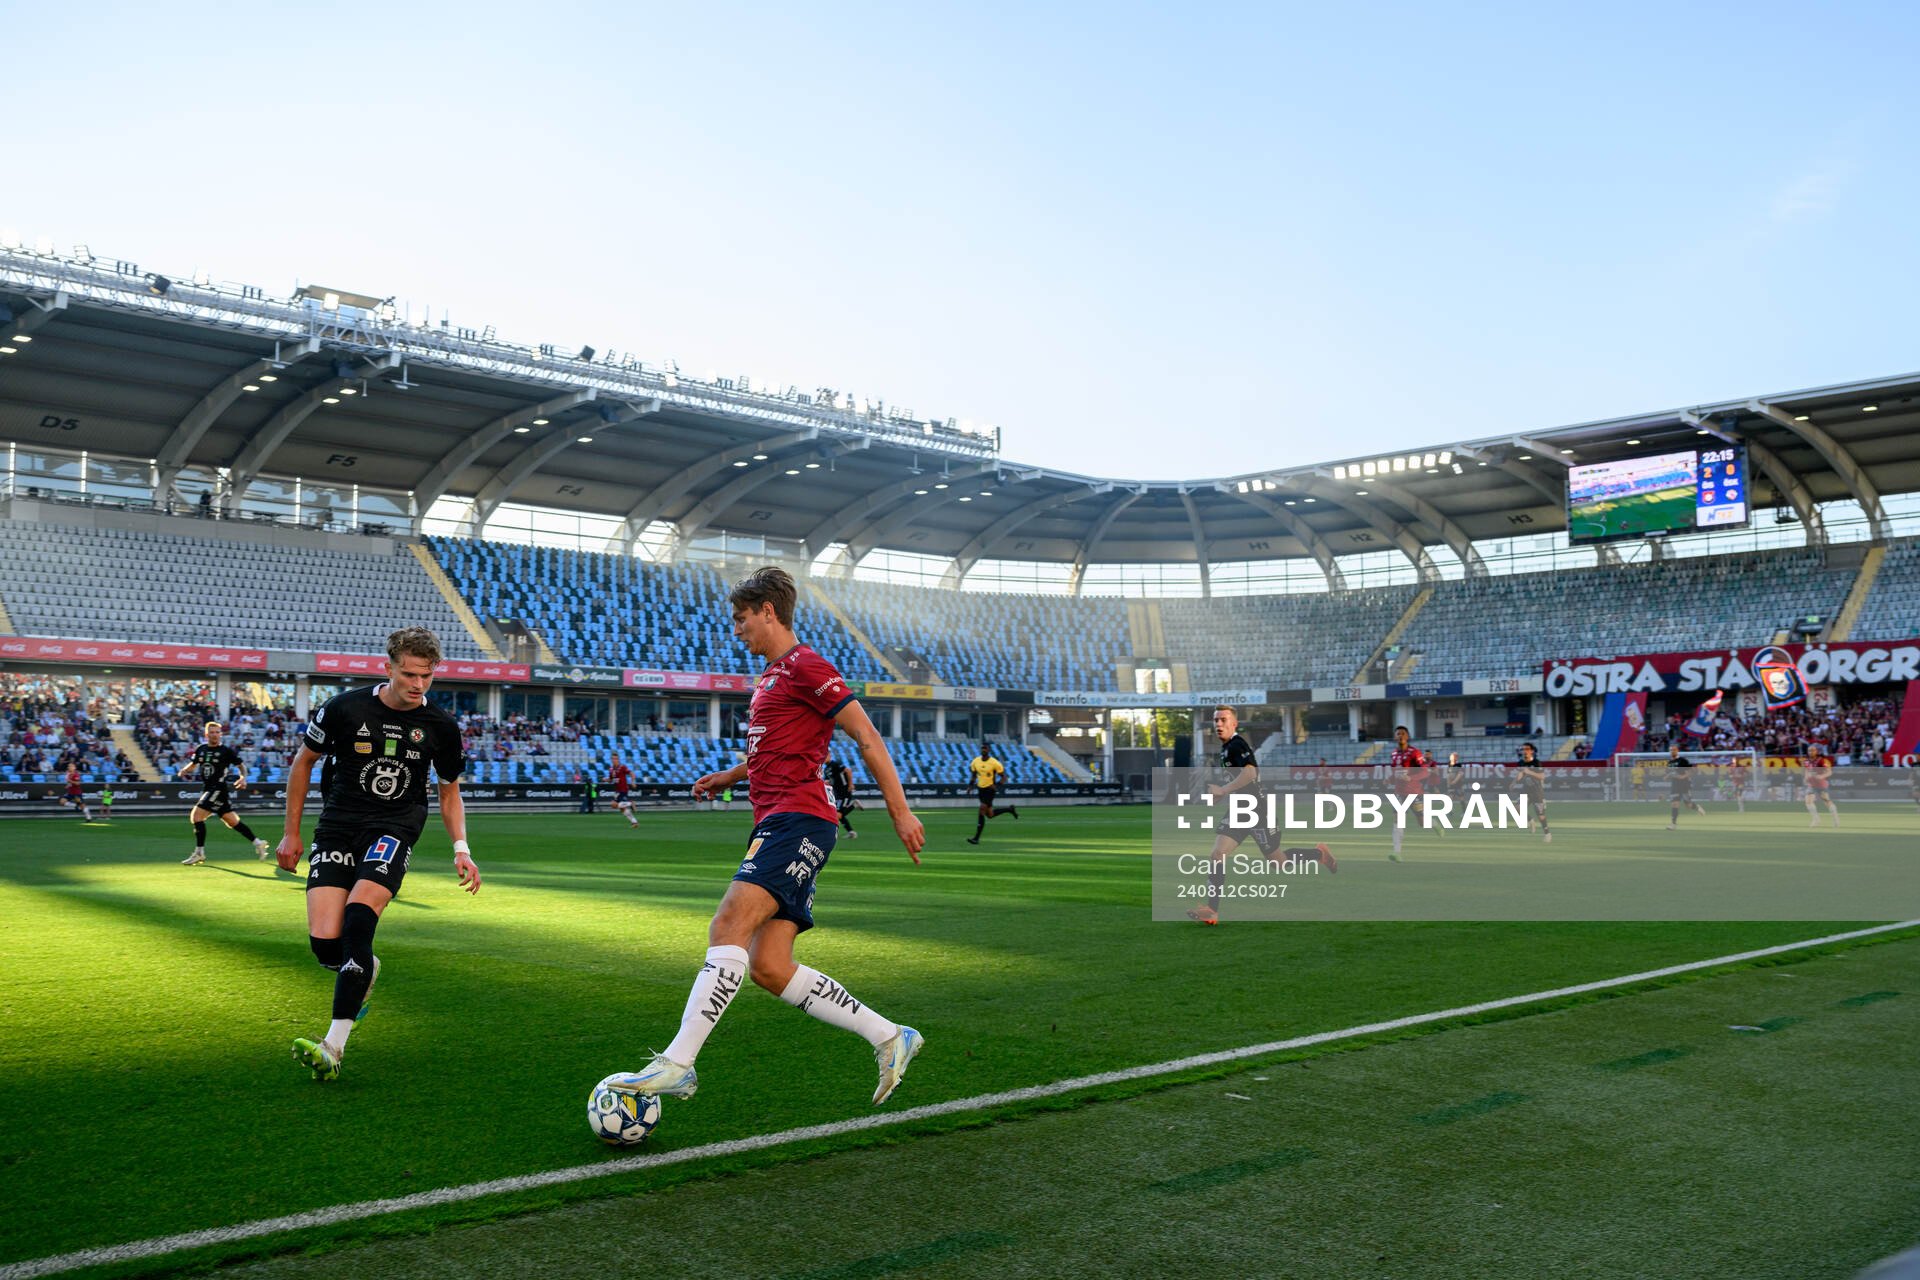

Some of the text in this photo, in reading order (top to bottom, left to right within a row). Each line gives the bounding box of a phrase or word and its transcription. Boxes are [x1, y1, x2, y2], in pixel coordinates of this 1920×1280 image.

[39, 415, 80, 431] D5
[325, 454, 358, 468] F5
[1702, 449, 1734, 463] 22:15
[1703, 464, 1735, 478] 2 0
[556, 484, 582, 497] F4
[749, 510, 773, 522] F3
[1507, 513, 1534, 525] H3
[1349, 532, 1375, 544] H2
[1248, 541, 1271, 551] H1
[1545, 661, 1667, 697] ÖSTRA
[1677, 649, 1758, 692] STÅ
[1489, 680, 1520, 692] FAT21
[1334, 688, 1361, 700] FAT21
[311, 868, 319, 878] 4
[700, 967, 742, 1023] MIKE
[810, 975, 861, 1015] MIKE
